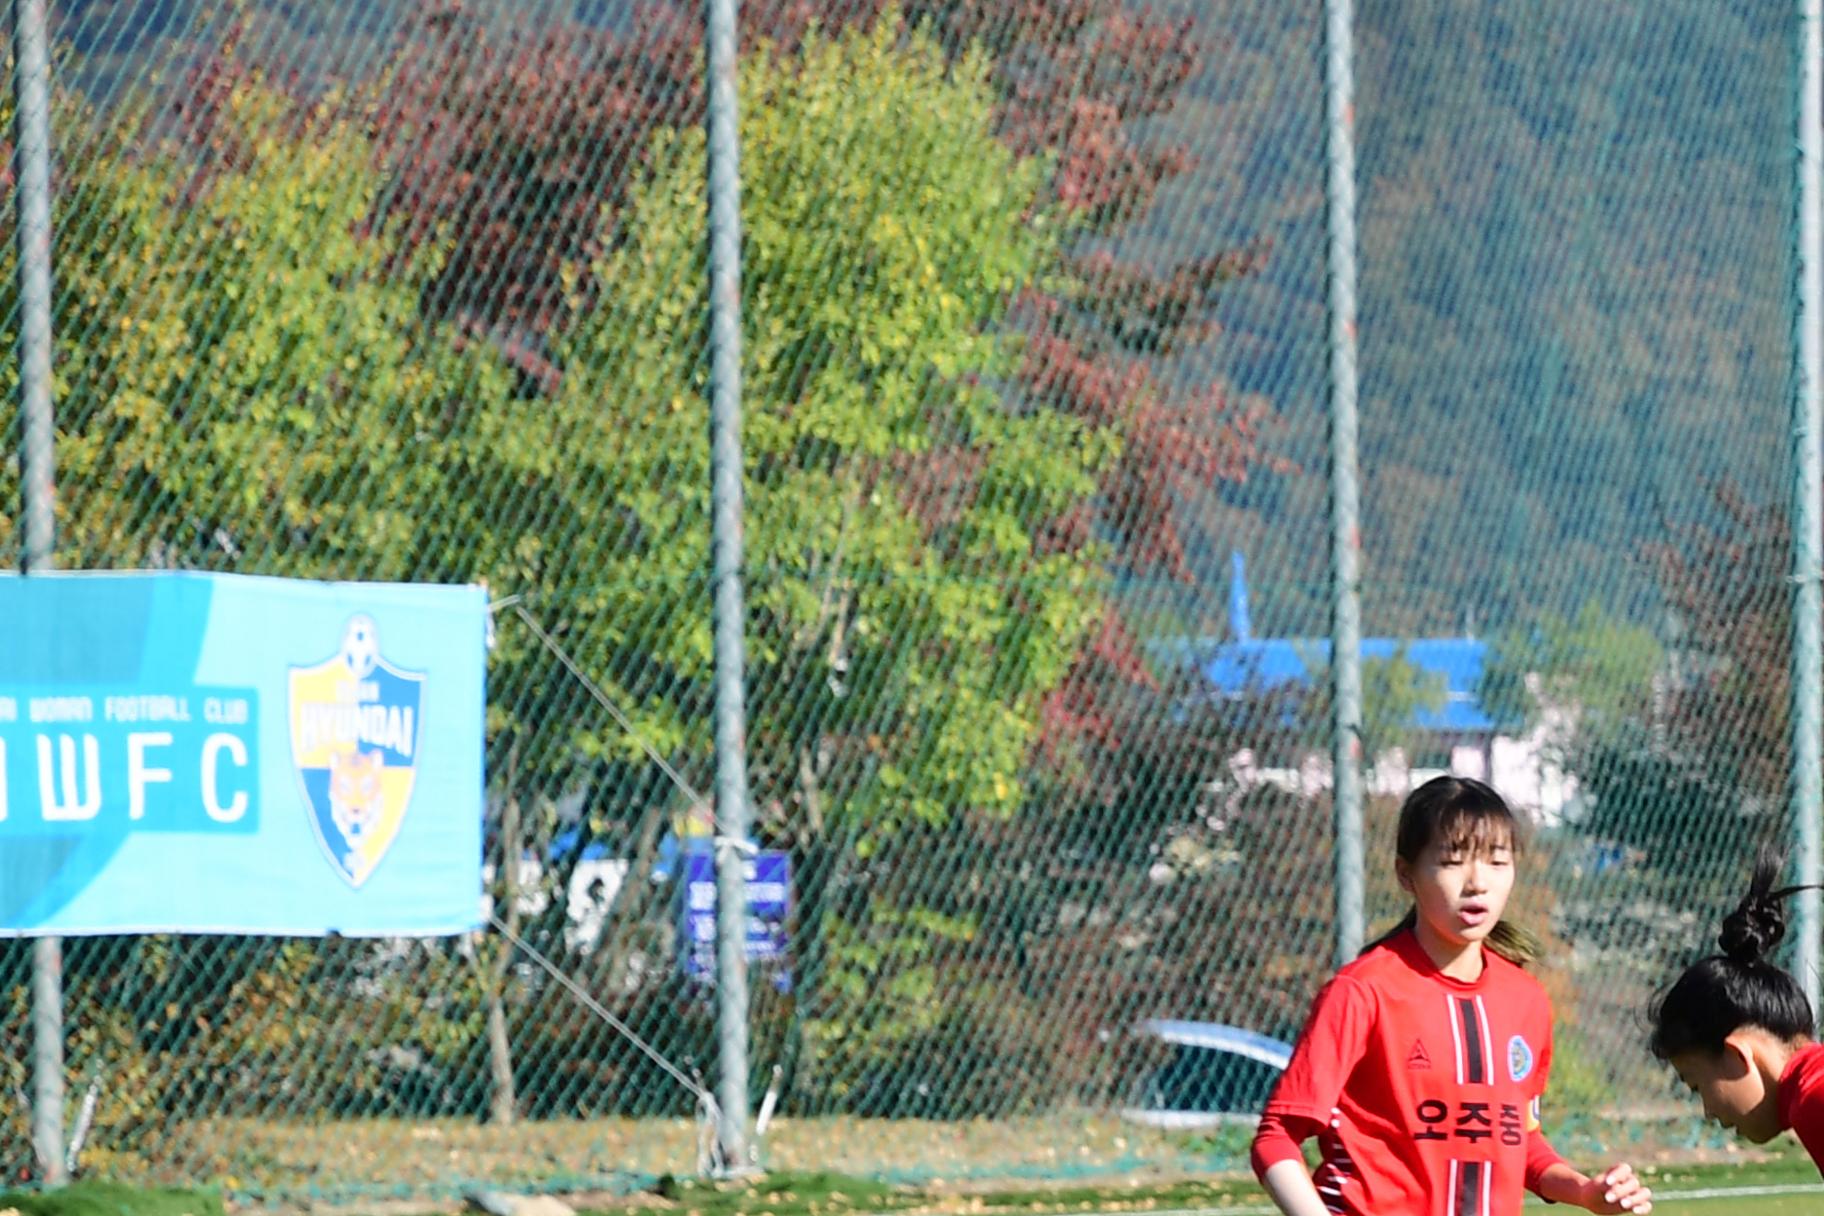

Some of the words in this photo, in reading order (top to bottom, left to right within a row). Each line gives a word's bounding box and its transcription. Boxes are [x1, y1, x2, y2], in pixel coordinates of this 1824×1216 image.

[104, 695, 191, 721] FOOTBALL
[204, 697, 248, 724] CLUB
[301, 703, 413, 757] HYUNDAI
[0, 732, 249, 823] WFC
[1414, 1099, 1521, 1146] 오주중
